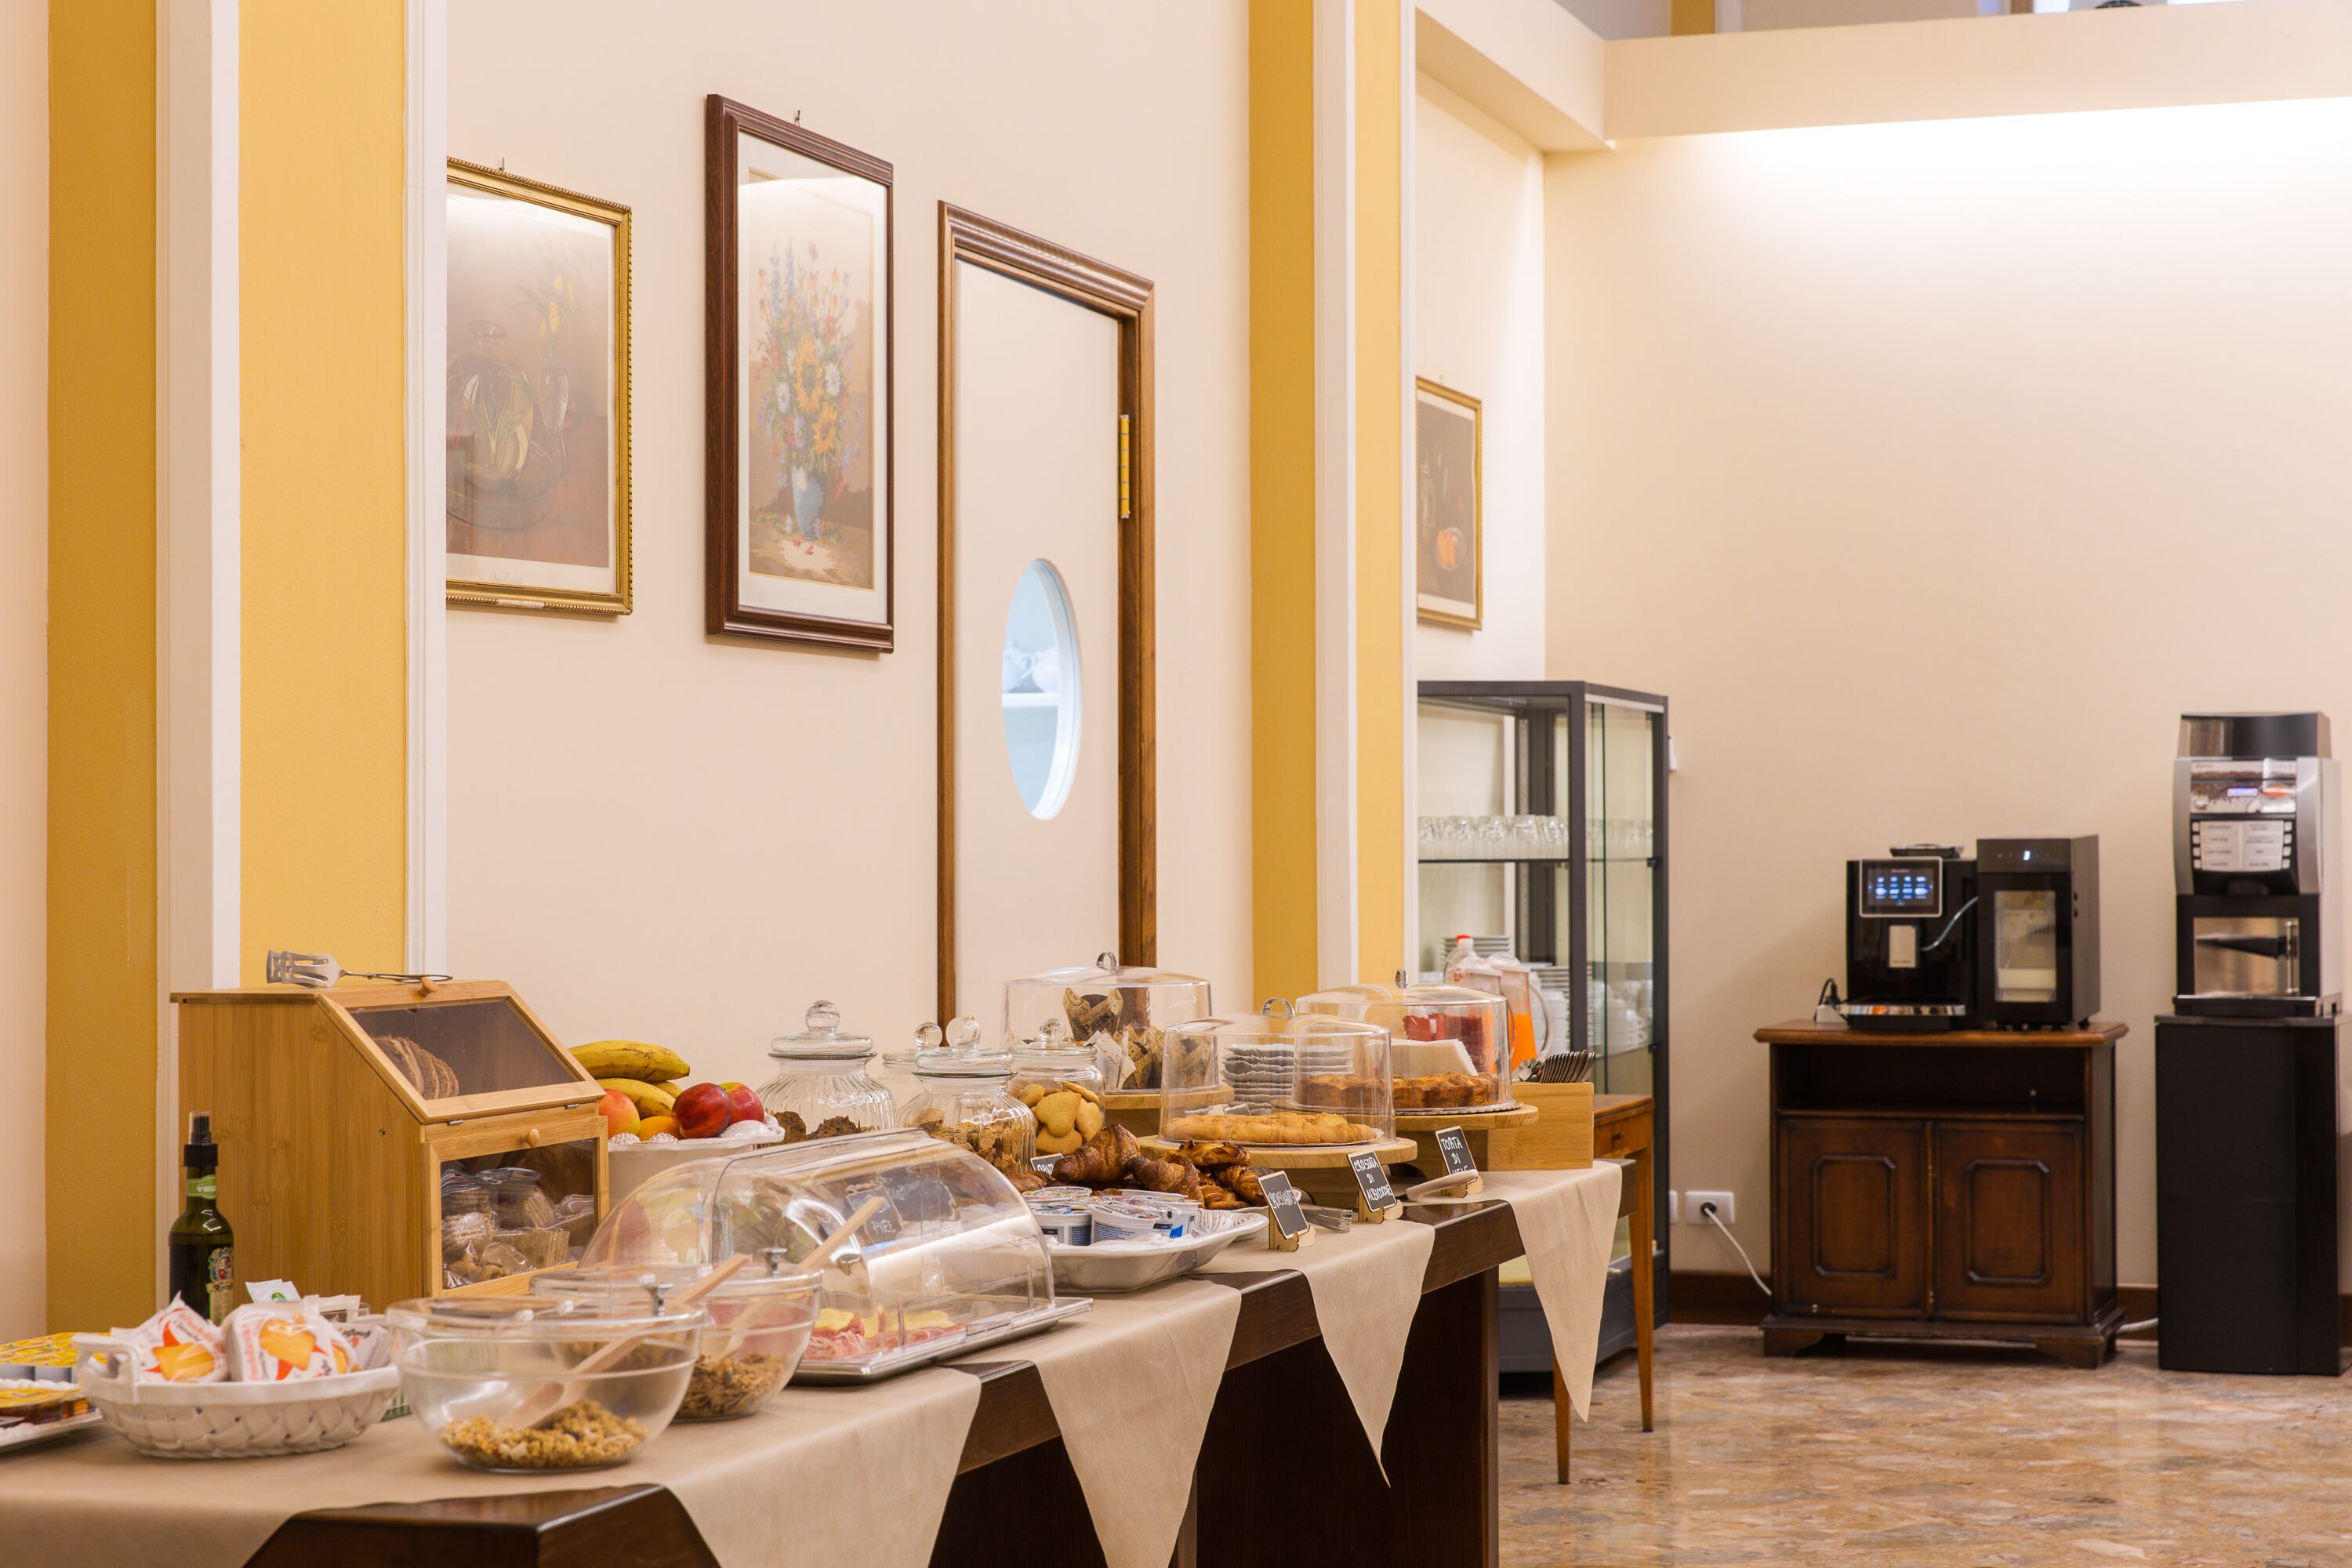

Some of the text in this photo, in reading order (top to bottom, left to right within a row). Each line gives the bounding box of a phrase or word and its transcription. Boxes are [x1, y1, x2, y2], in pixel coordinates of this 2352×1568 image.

[1440, 1136, 1463, 1151] TORTA
[1451, 1152, 1461, 1165] DI
[1366, 1173, 1375, 1184] DI
